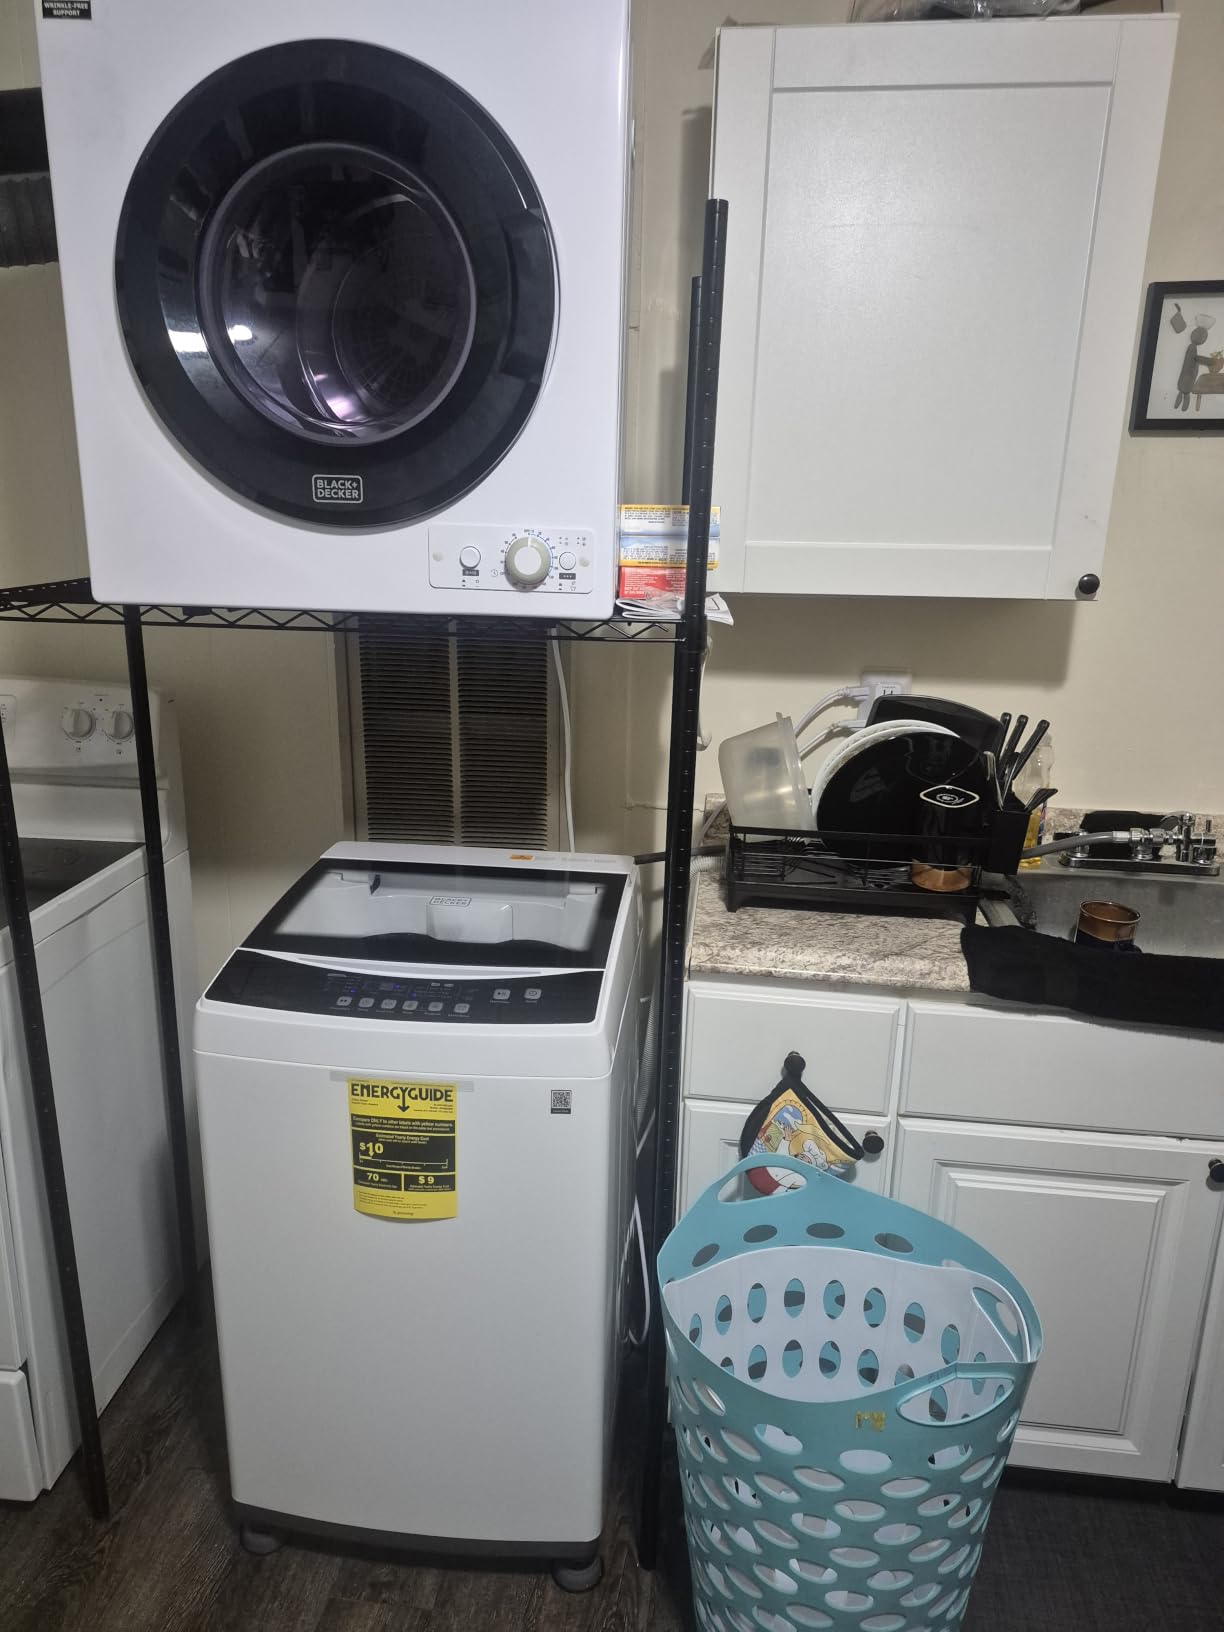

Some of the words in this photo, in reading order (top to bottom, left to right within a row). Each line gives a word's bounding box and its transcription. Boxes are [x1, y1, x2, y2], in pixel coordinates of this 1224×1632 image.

[316, 479, 358, 489] BLACK+
[317, 488, 359, 498] DECKER
[351, 1083, 453, 1102] ENERGYGUIDE
[359, 1142, 384, 1154] $10
[367, 1172, 379, 1182] 70
